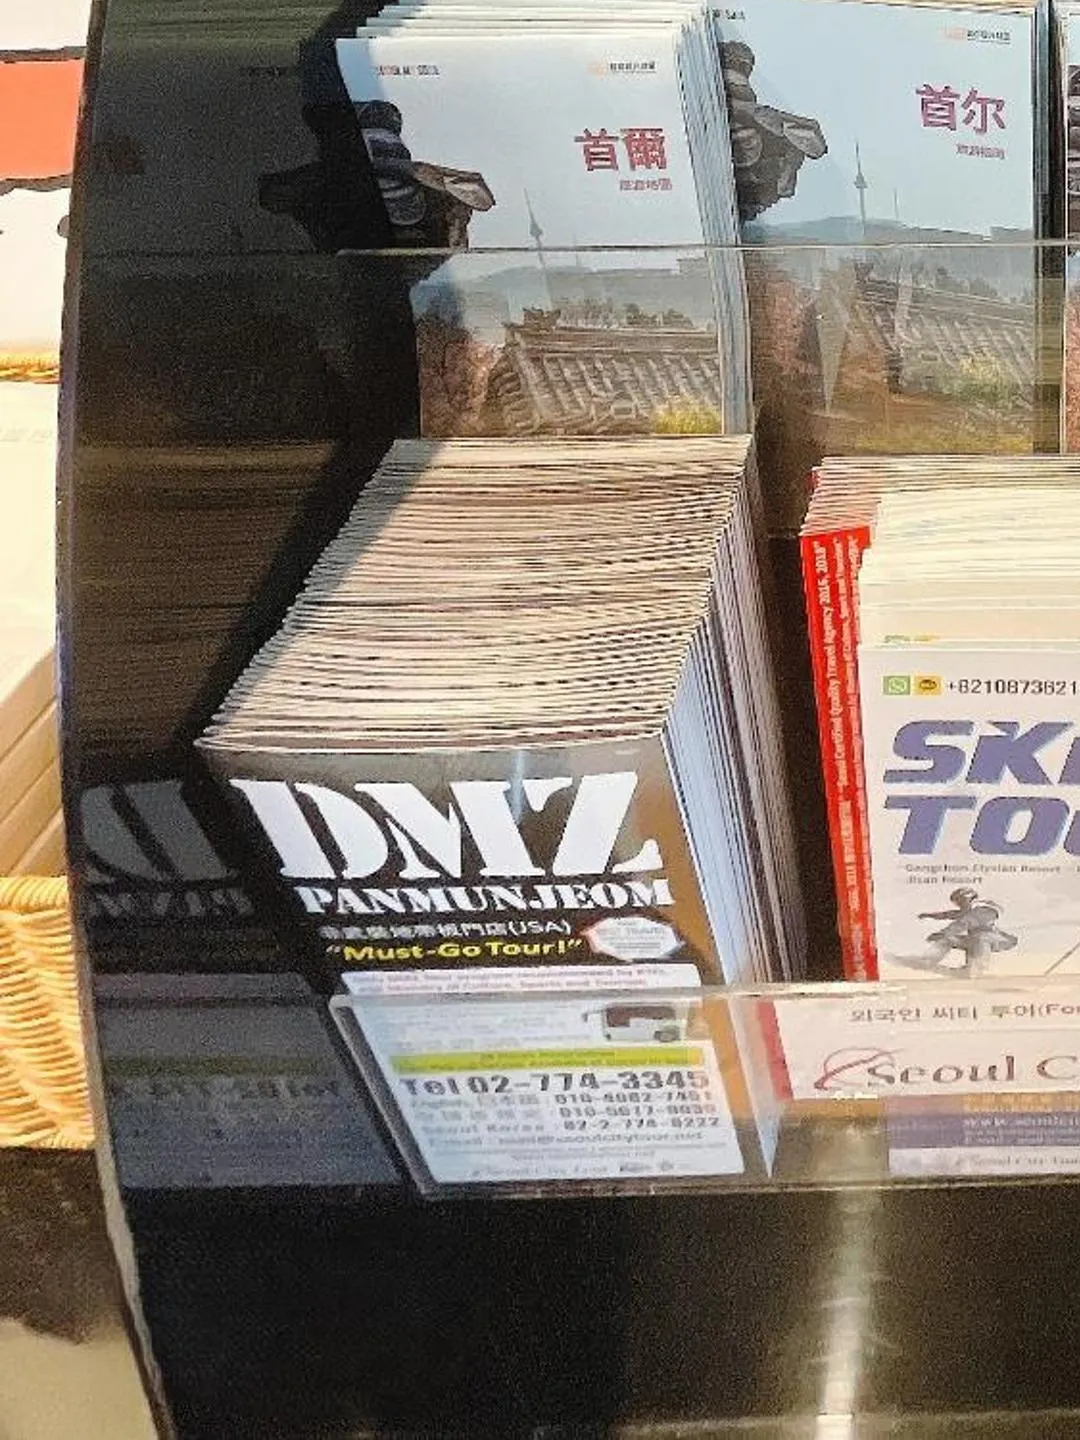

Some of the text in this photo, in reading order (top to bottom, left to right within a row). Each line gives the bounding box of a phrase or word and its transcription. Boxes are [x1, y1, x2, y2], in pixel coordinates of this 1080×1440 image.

[915, 82, 1007, 135] 首尔
[573, 127, 668, 172] 首爾
[824, 643, 837, 678] Travel
[229, 771, 665, 880] DMZ
[293, 878, 676, 919] PANMUNJEOM
[850, 1007, 922, 1024] 외국인
[933, 1005, 978, 1022] 씨티
[400, 1075, 461, 1096] Tel
[866, 1054, 1015, 1086] Seoul
